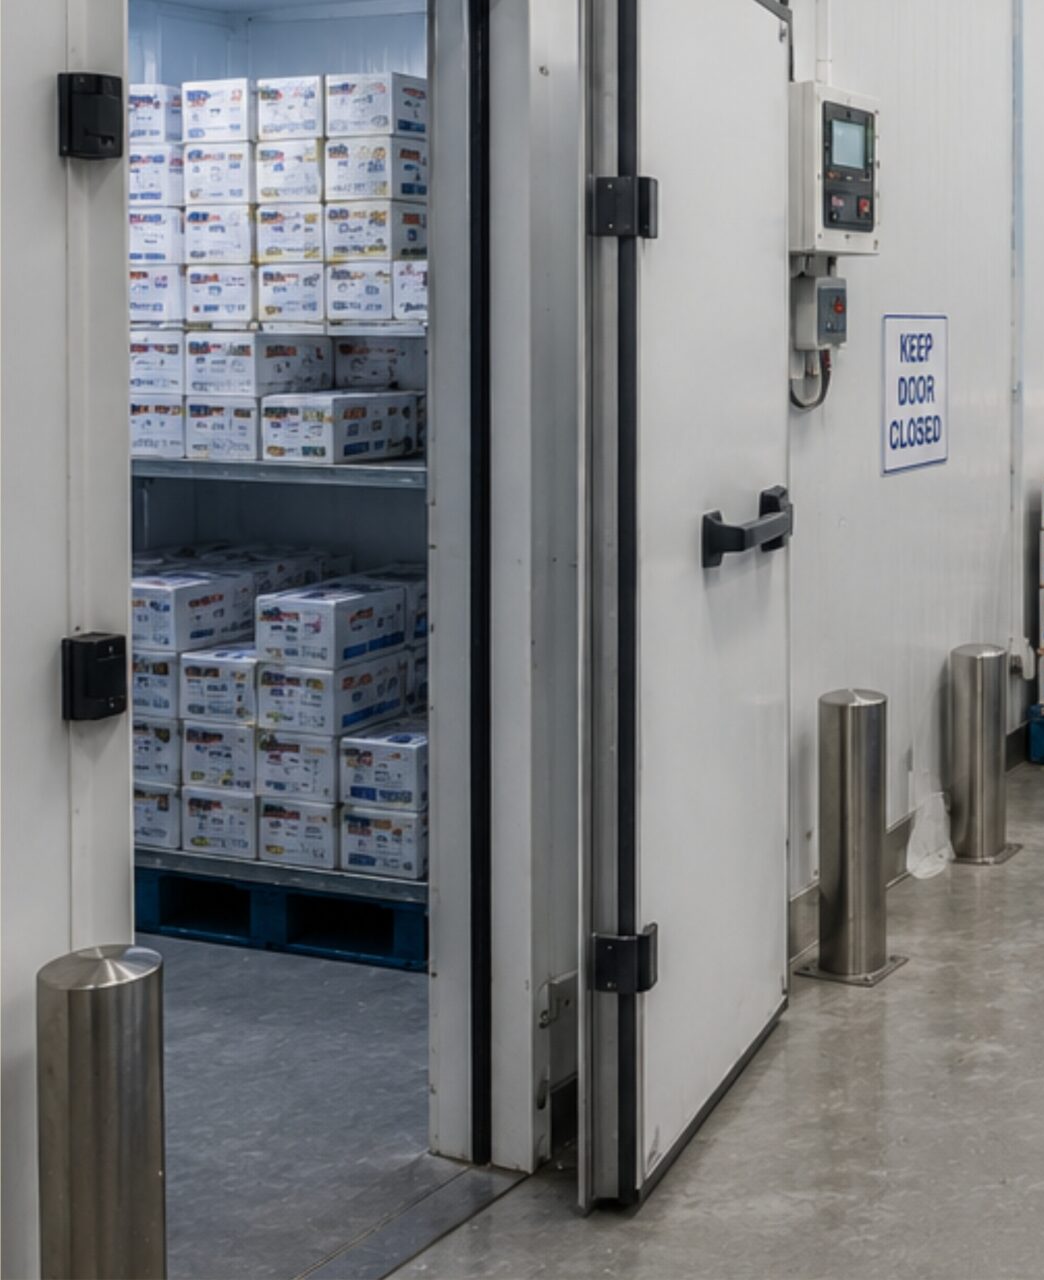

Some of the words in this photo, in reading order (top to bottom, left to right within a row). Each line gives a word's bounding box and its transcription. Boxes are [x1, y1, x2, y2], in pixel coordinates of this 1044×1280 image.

[900, 333, 932, 362] KEEP
[898, 374, 935, 405] DOOR
[889, 415, 941, 450] CLOSED
